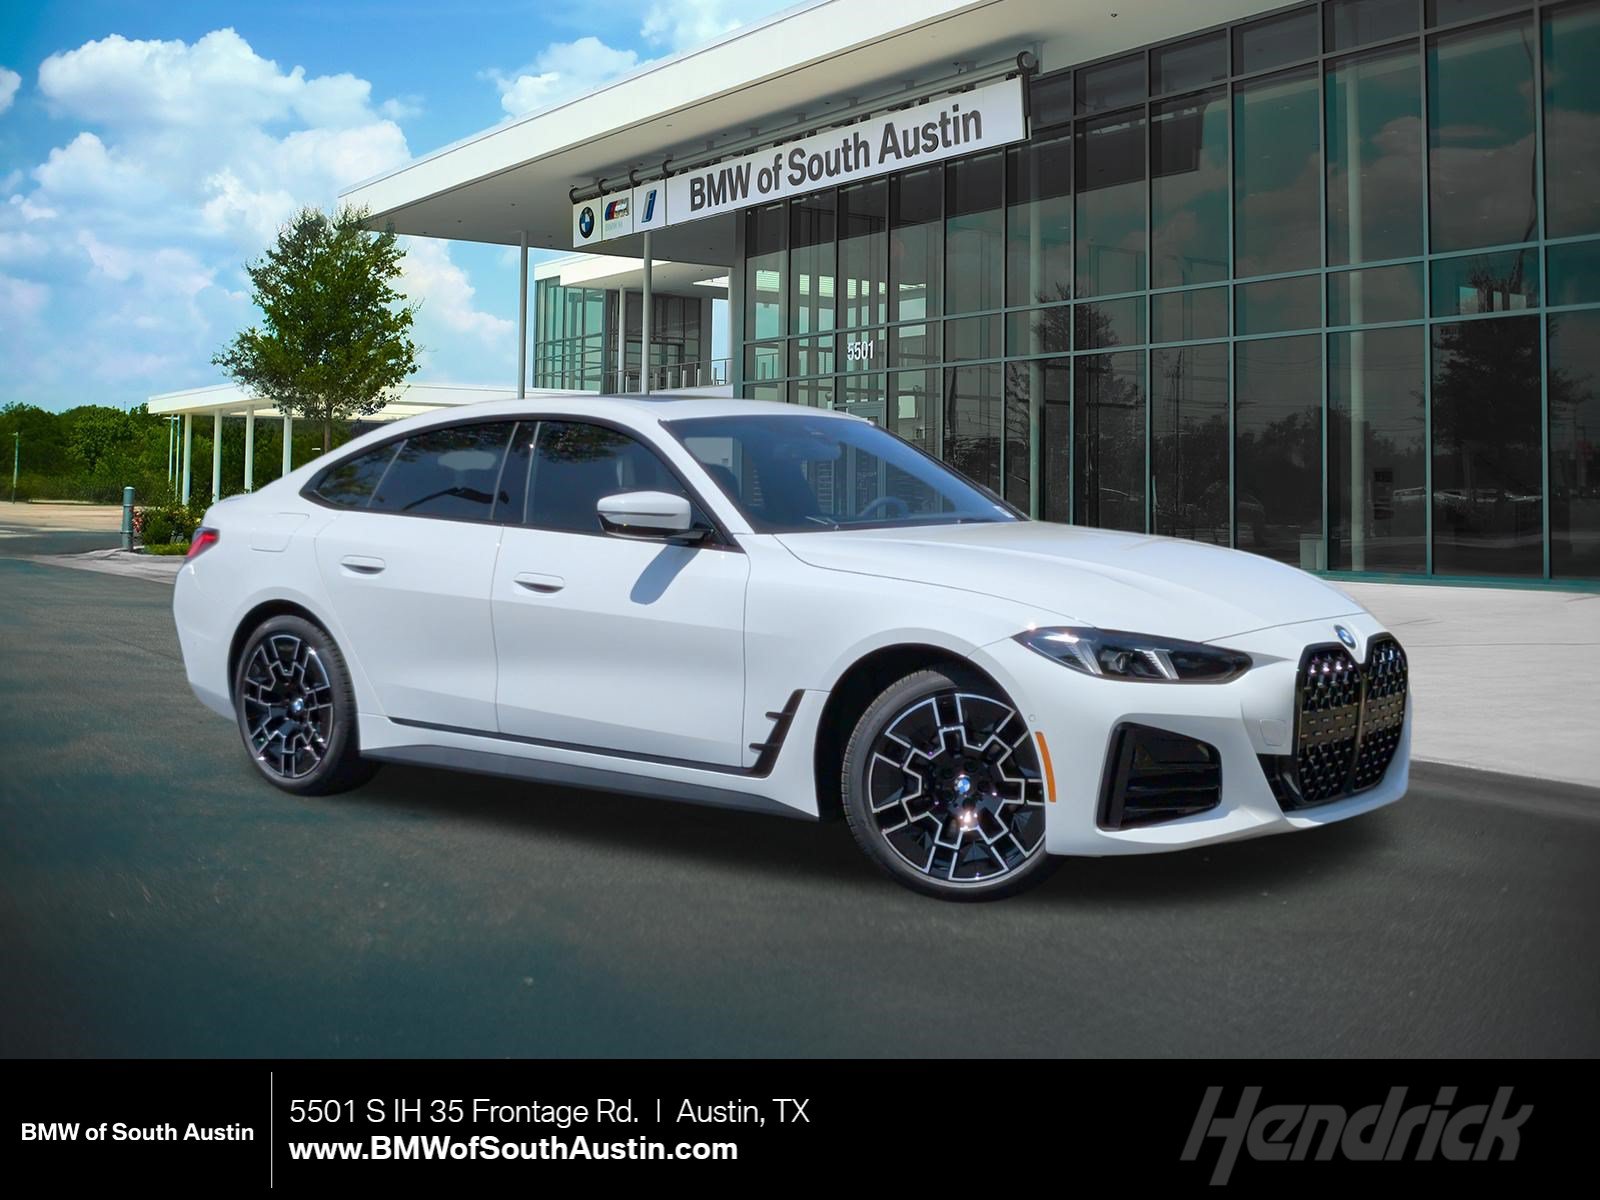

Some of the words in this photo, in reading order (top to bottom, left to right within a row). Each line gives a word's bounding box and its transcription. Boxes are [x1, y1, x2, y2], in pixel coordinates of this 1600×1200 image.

[689, 162, 752, 212] BMW
[757, 153, 783, 194] of
[787, 131, 870, 186] South
[878, 103, 982, 164] Austin
[847, 340, 874, 361] 5501
